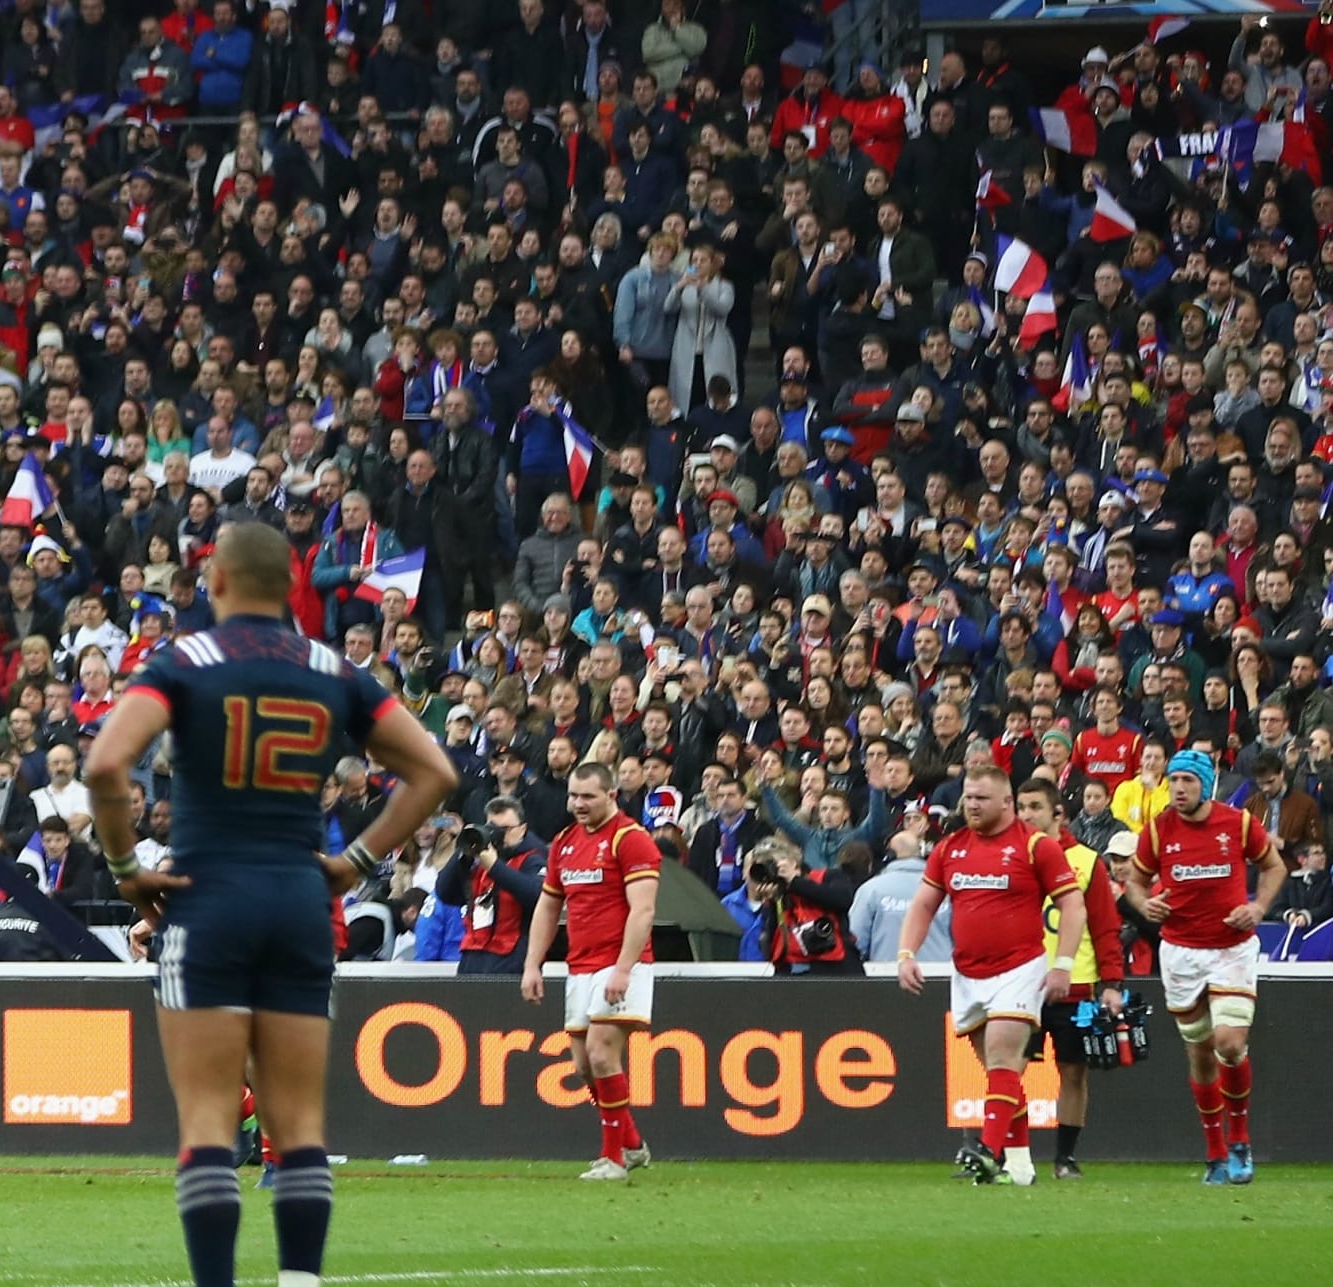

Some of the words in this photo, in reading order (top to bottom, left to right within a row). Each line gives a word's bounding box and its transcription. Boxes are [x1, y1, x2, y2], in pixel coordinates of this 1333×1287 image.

[223, 695, 332, 793] 12
[963, 874, 1008, 887] Admiral
[1184, 865, 1231, 877] Admiral
[10, 1094, 119, 1123] orange
